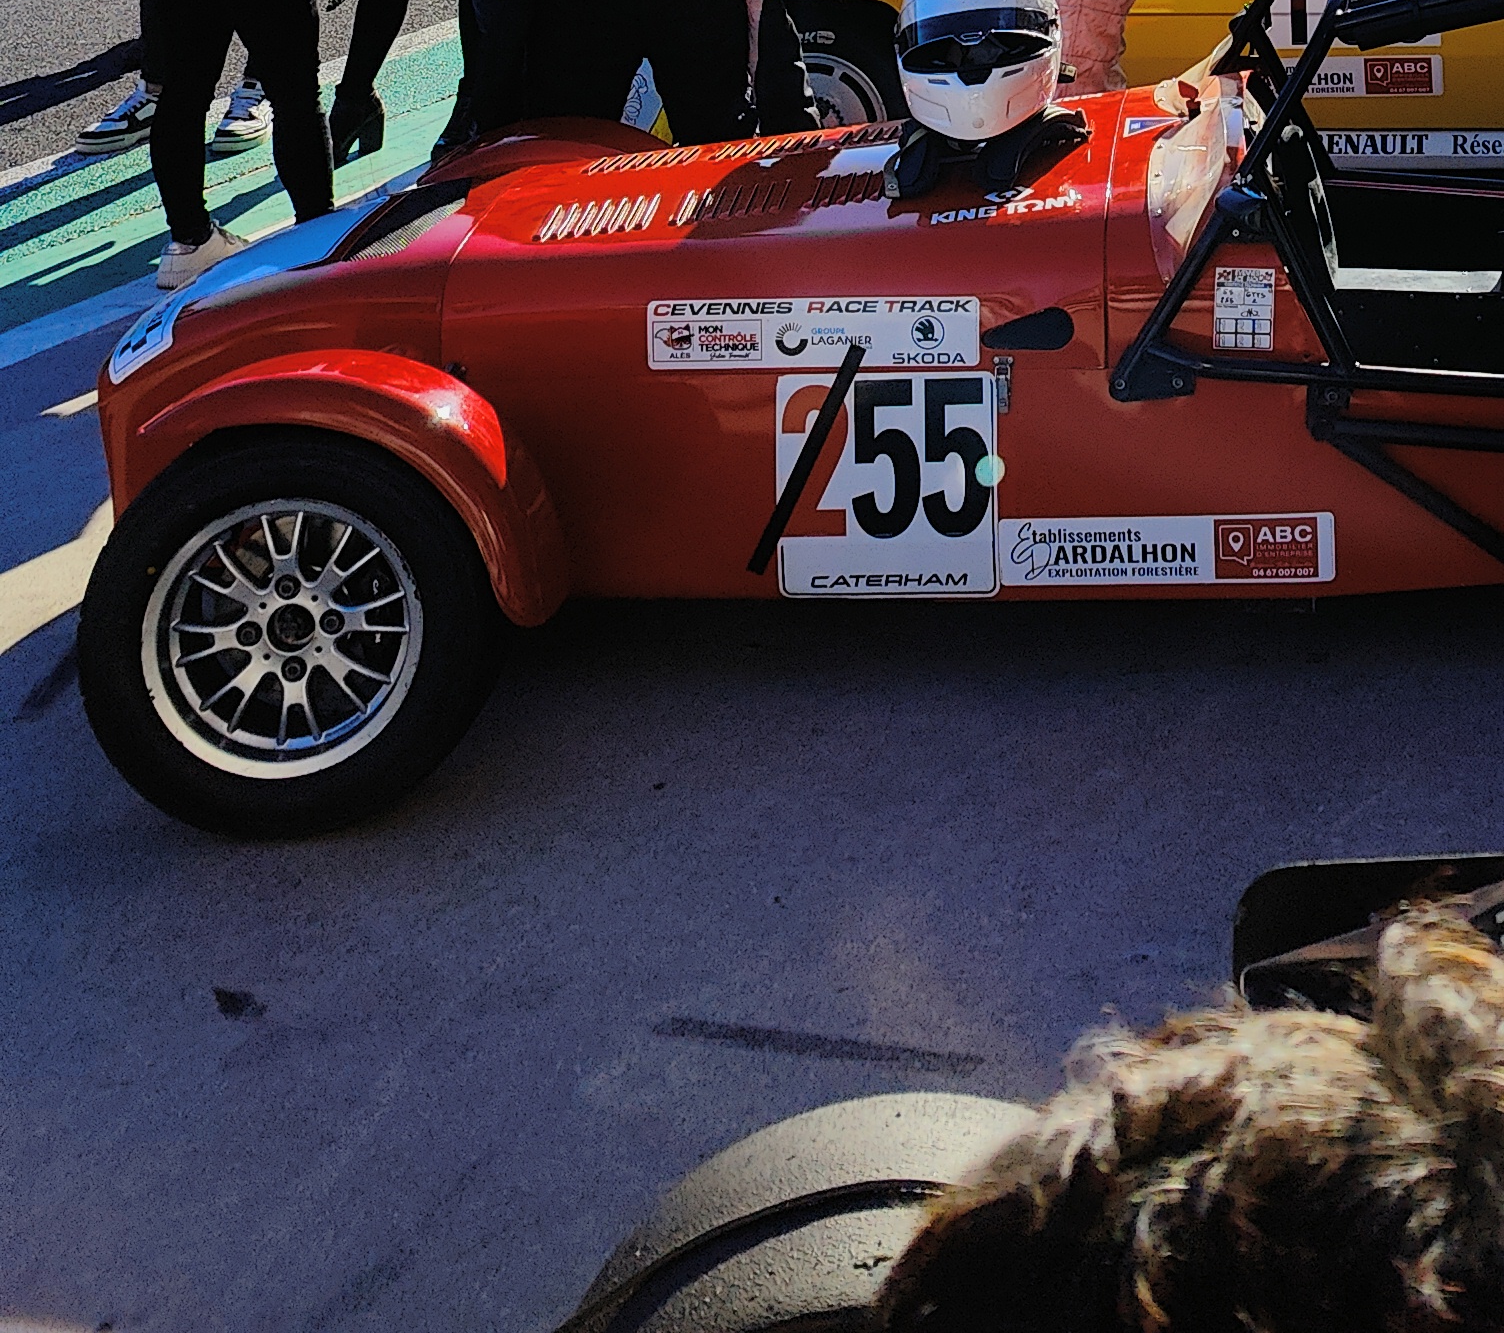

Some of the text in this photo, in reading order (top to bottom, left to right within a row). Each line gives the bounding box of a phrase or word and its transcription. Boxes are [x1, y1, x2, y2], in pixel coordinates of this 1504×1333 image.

[1391, 62, 1429, 74] ABC
[930, 204, 998, 226] KING
[653, 299, 973, 317] CEVENNES RACE TRACK
[698, 325, 723, 334] MON
[811, 327, 846, 335] GROUPE
[698, 331, 757, 343] CONTRÔLE
[811, 335, 873, 346] LAGANIER
[698, 342, 760, 352] TECHNIQUE
[1256, 525, 1313, 543] ABC
[1048, 564, 1200, 578] EXPLOITATION FORESTIÈRE
[1252, 567, 1315, 577] 04 67 007 007
[810, 573, 969, 590] CATERHAM
